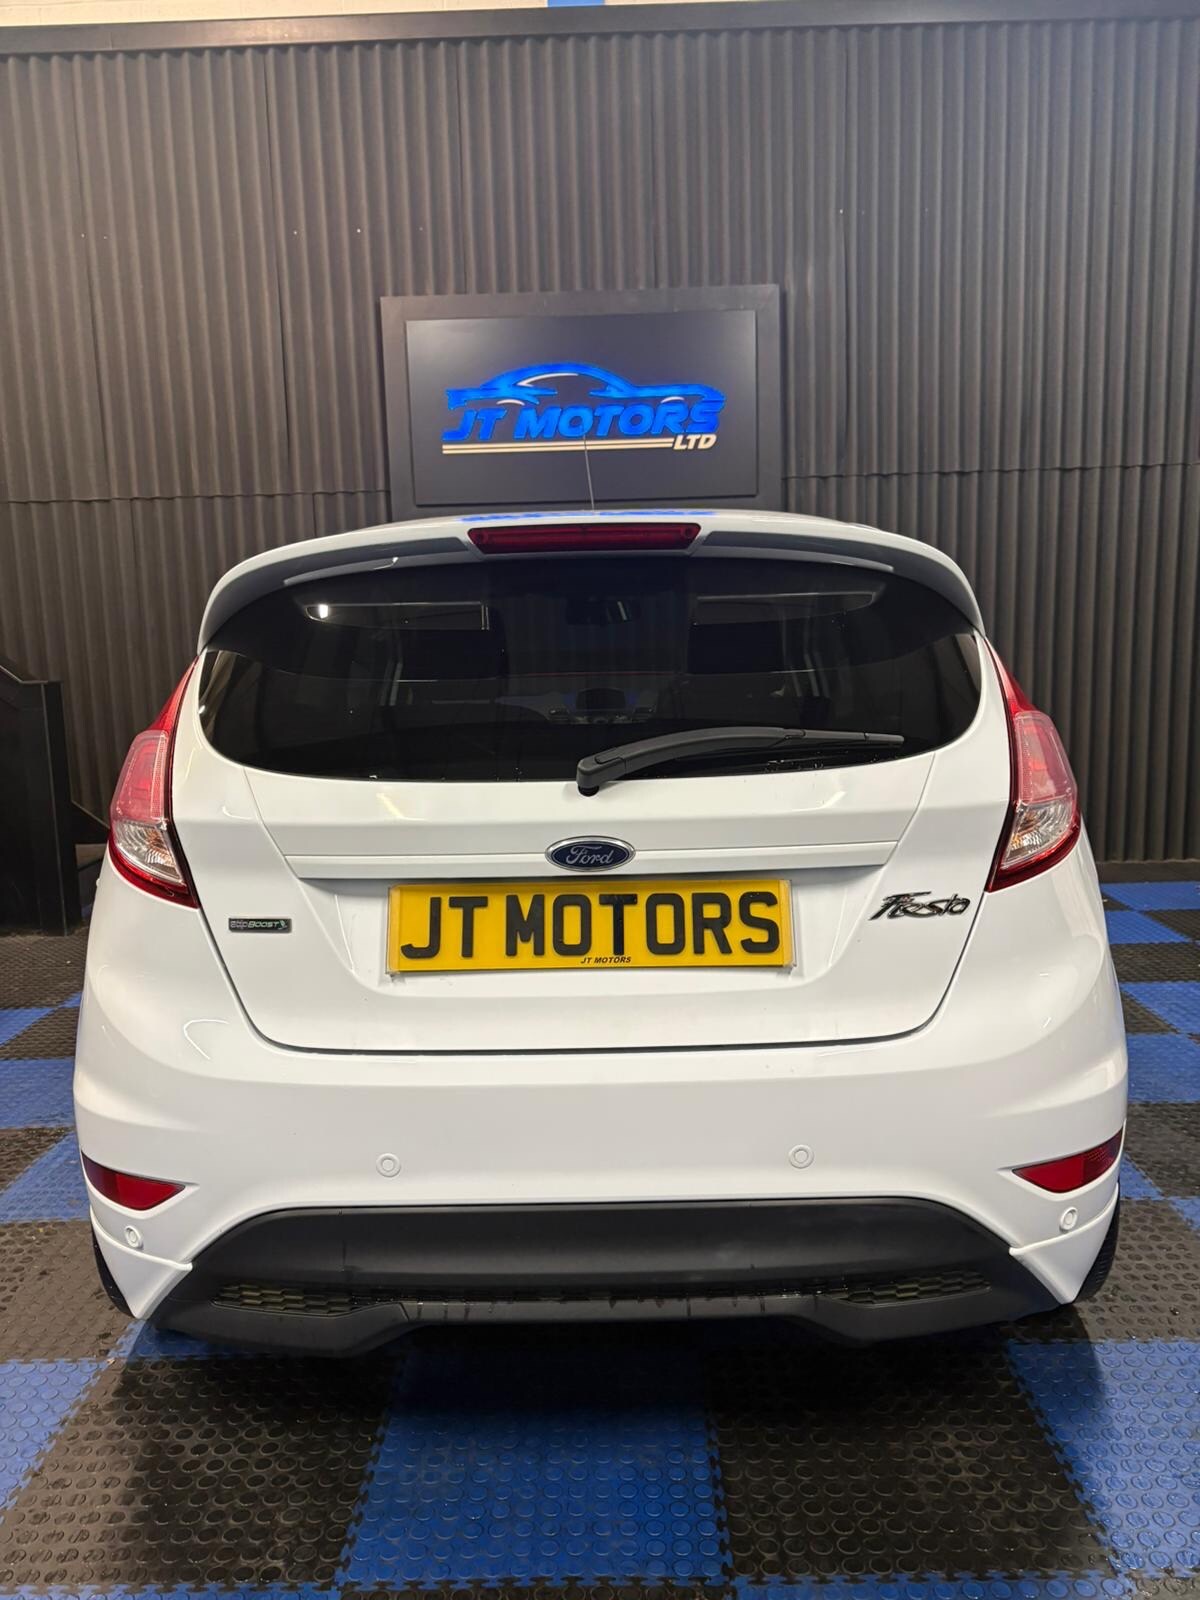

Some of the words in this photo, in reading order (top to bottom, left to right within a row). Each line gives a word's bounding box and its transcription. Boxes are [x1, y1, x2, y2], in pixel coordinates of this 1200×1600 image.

[441, 407, 507, 441] JT
[513, 402, 723, 440] MOTORS
[673, 434, 717, 450] LTD
[566, 845, 614, 864] Ford
[400, 896, 489, 959] JT
[505, 891, 780, 957] MOTORS
[594, 956, 632, 964] MOTORS
